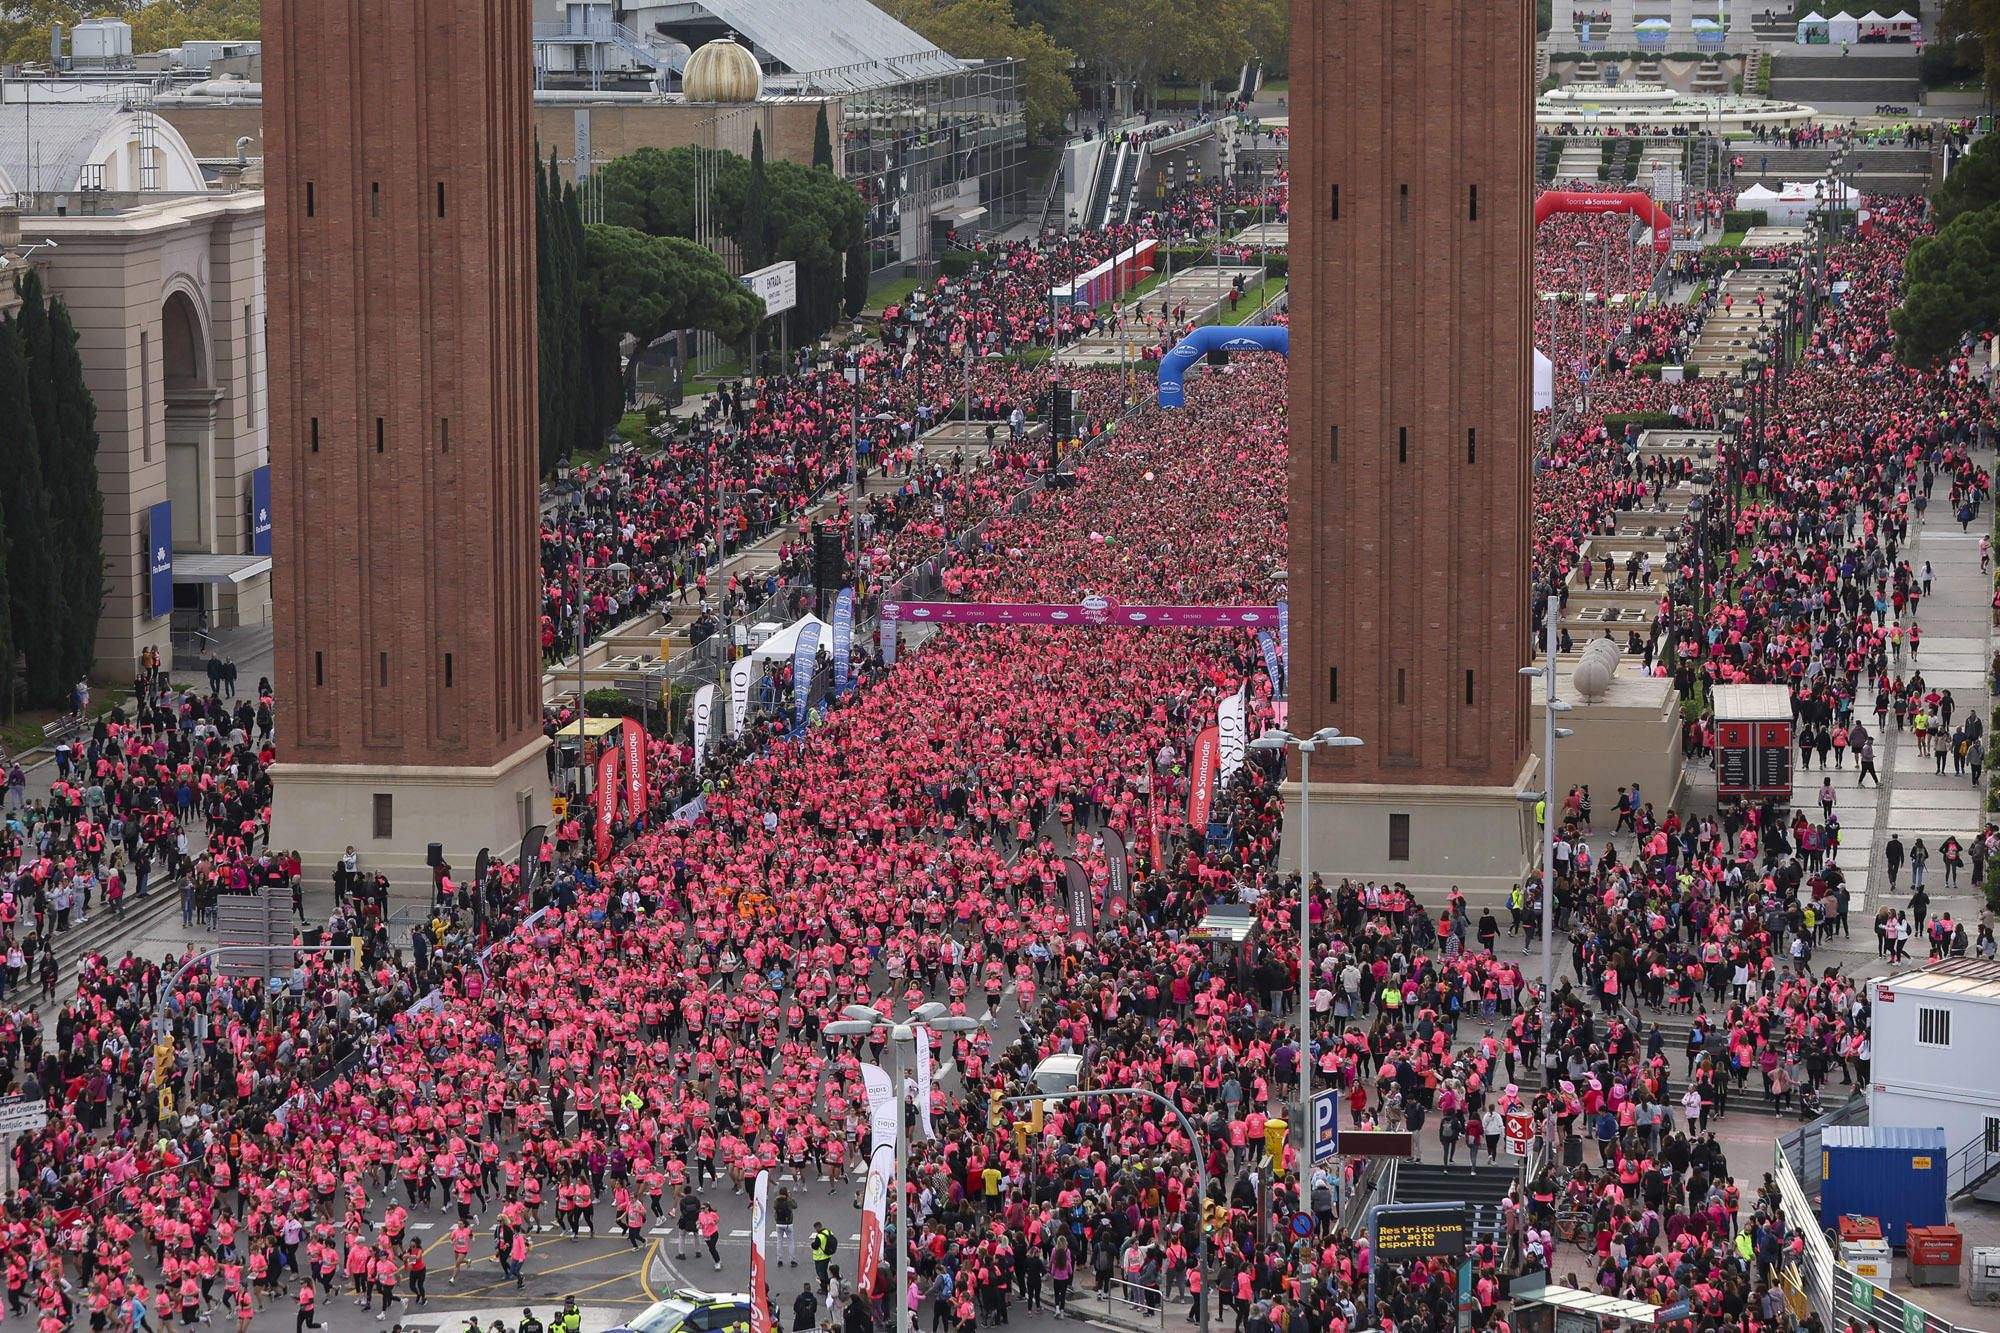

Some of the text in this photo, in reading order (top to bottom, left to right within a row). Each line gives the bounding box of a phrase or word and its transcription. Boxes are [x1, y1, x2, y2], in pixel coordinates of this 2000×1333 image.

[1198, 740, 1212, 787] Santander
[604, 763, 613, 811] Santander
[1315, 1097, 1333, 1144] P
[1514, 1143, 1524, 1152] L1
[1379, 1224, 1463, 1235] Restriccions
[1379, 1232, 1435, 1243] per acte
[1379, 1240, 1435, 1249] esportiu
